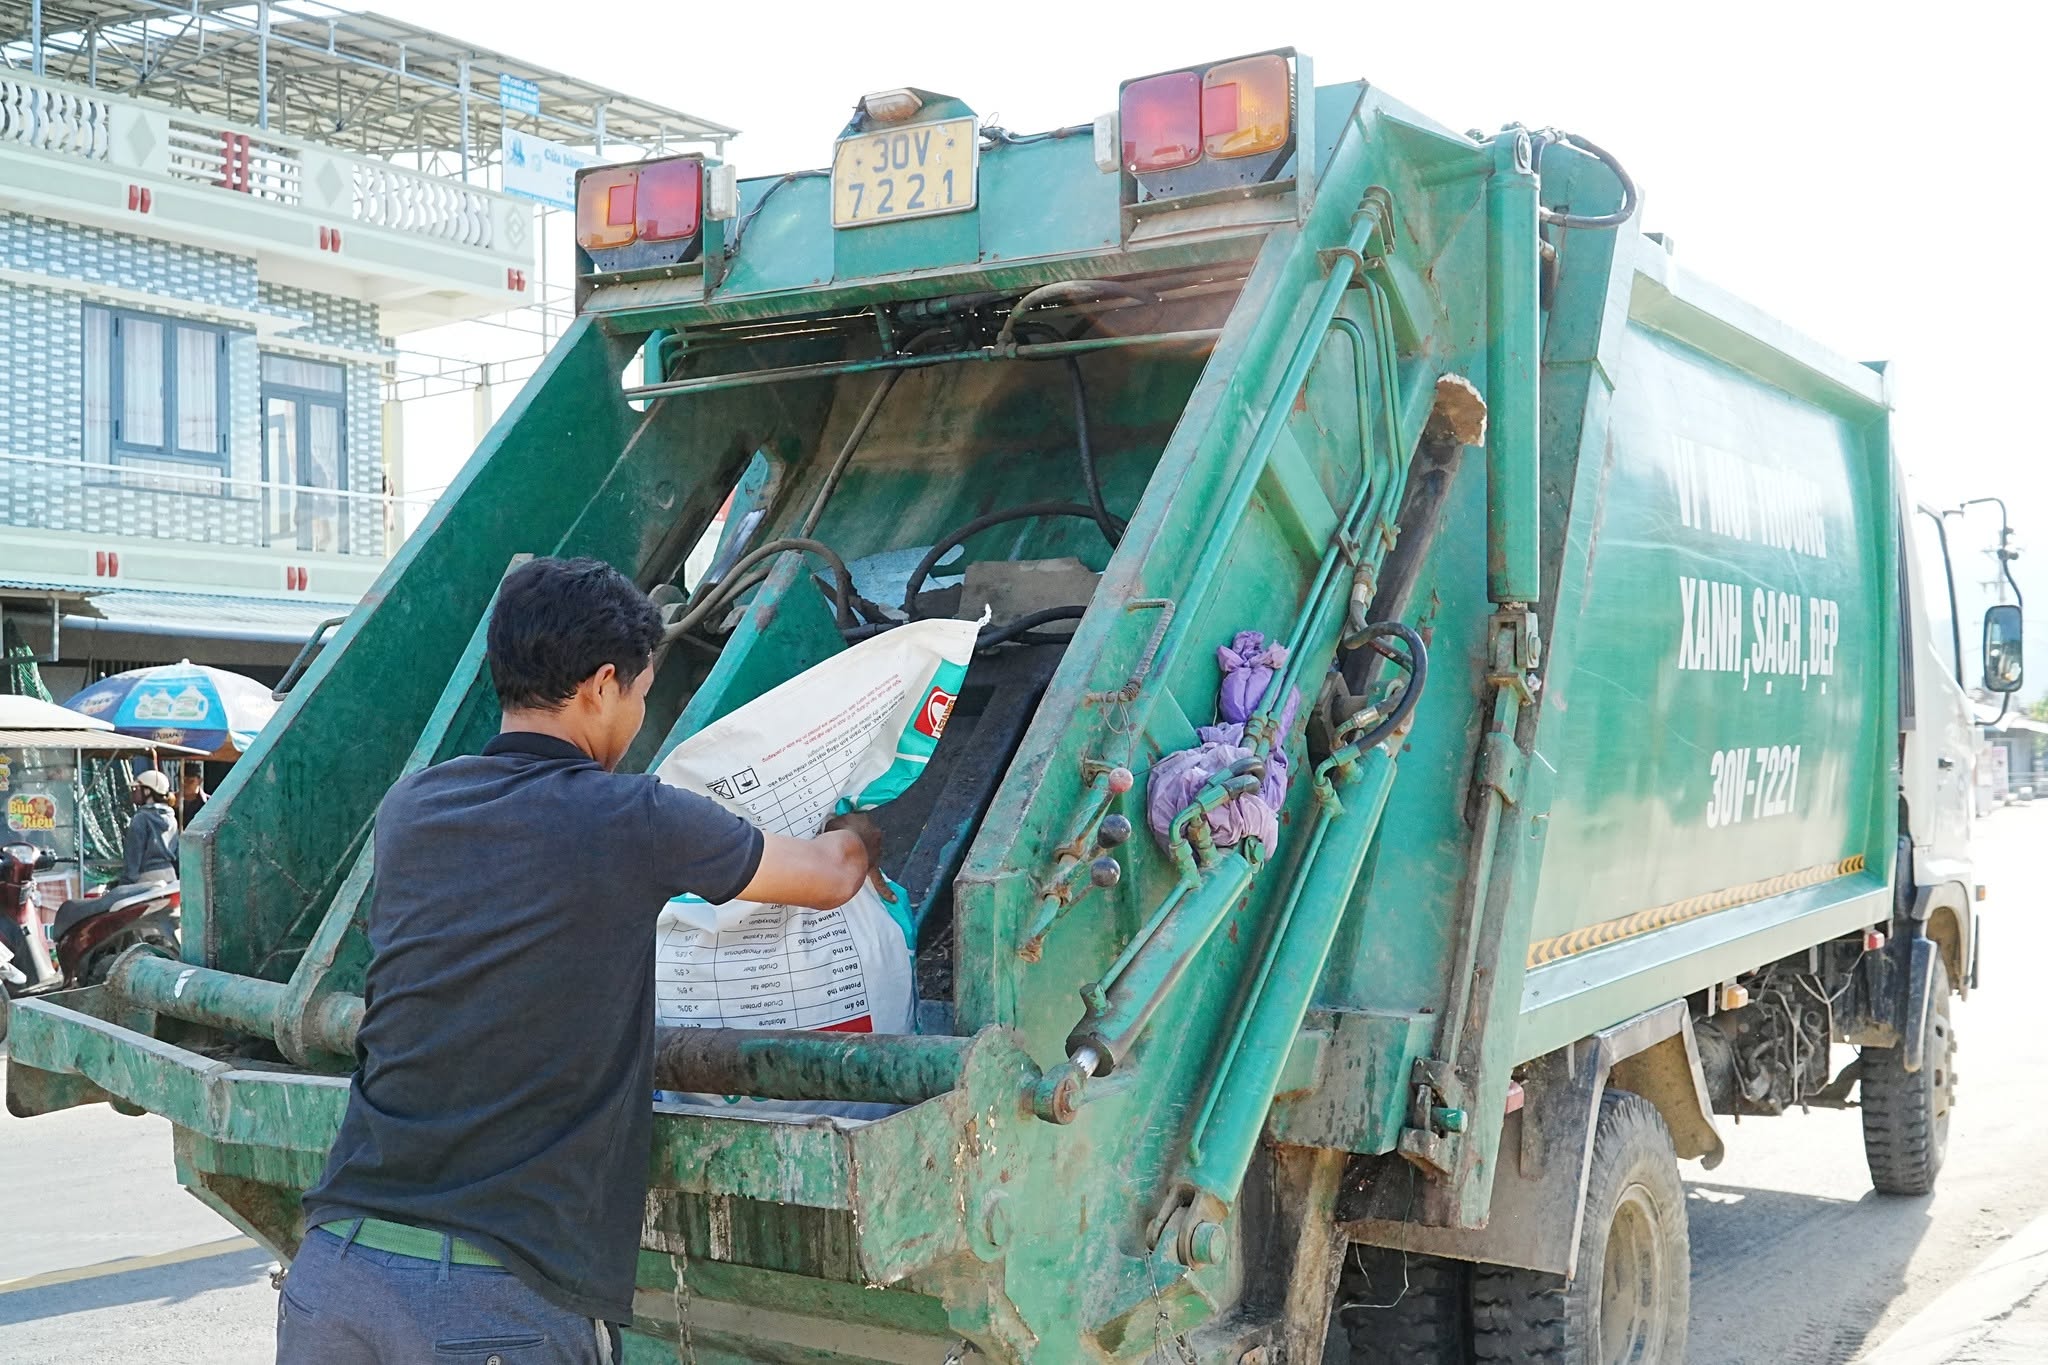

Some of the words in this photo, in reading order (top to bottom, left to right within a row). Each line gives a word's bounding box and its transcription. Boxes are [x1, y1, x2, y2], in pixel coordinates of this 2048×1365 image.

[872, 130, 930, 173] 30V
[848, 169, 953, 218] 7221
[1707, 744, 1801, 829] 30V-7221
[758, 963, 778, 971] Crude
[761, 981, 781, 989] Crude
[740, 1002, 762, 1010] protein
[758, 1018, 786, 1027] Moisture
